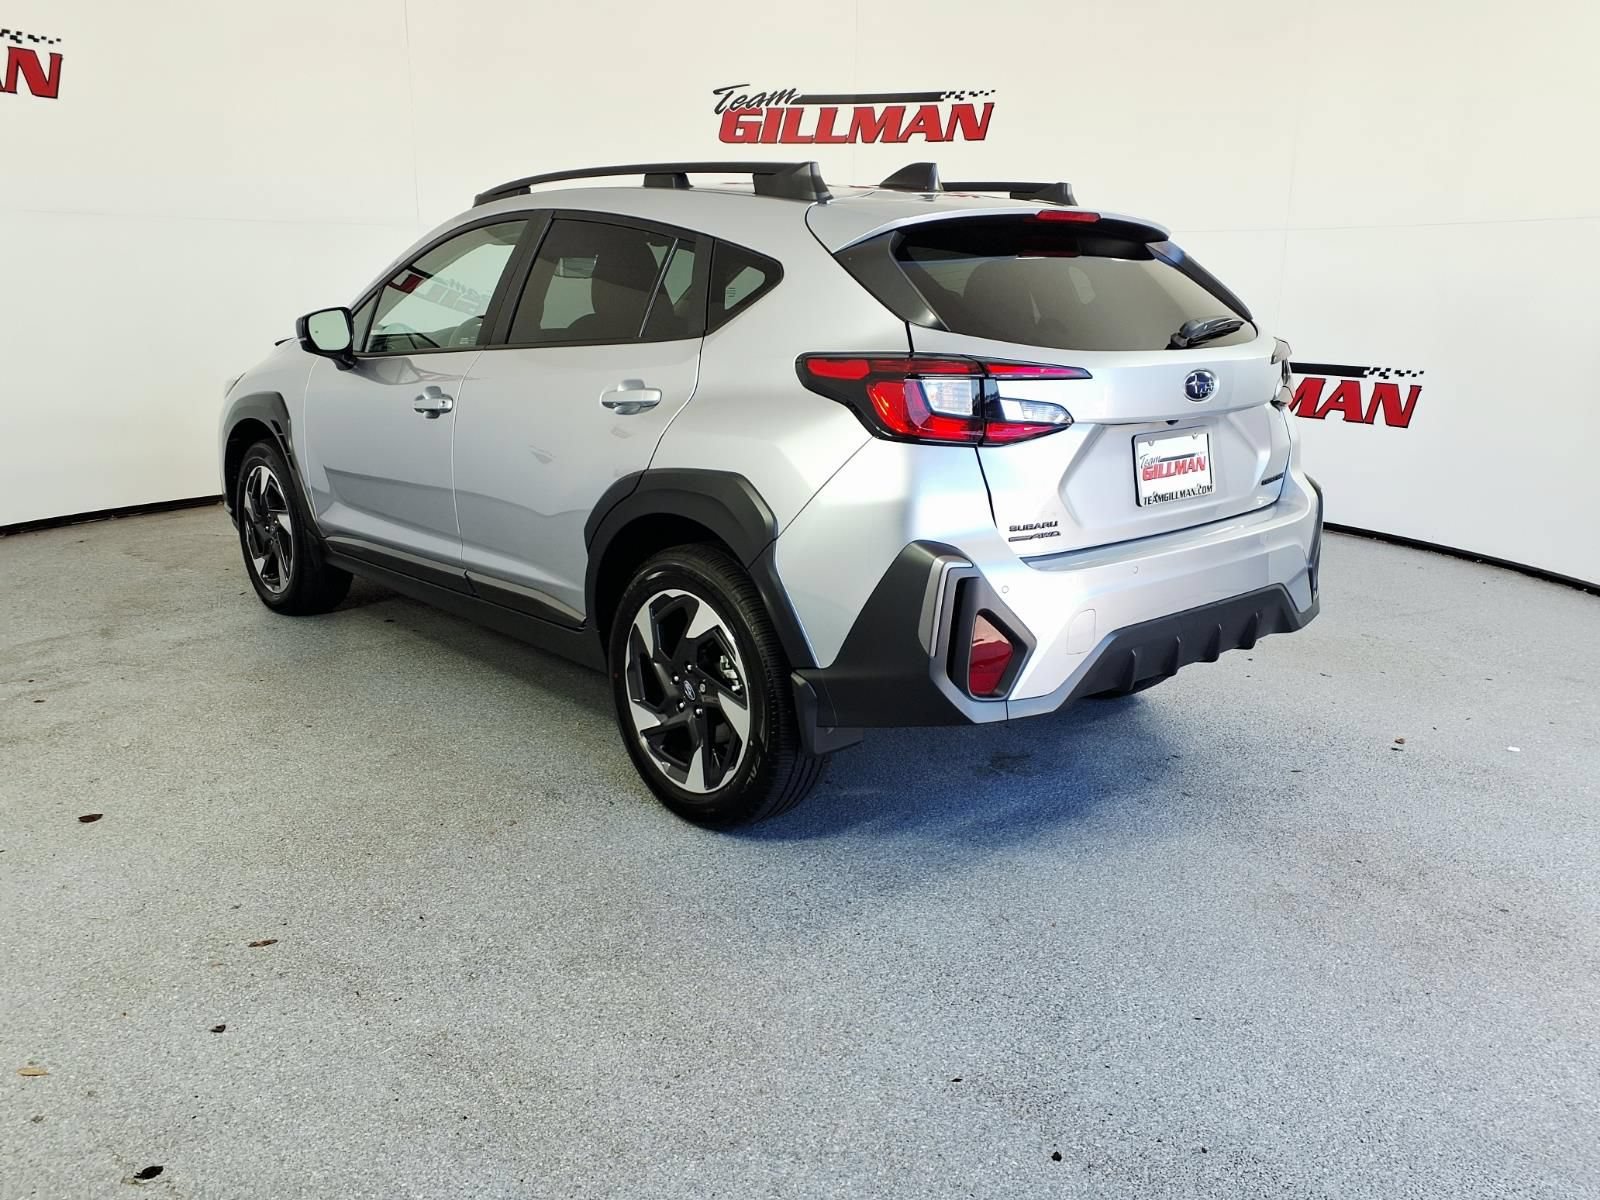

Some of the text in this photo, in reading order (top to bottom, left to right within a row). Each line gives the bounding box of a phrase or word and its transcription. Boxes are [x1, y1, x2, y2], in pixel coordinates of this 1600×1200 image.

[713, 84, 800, 115] Team
[719, 102, 995, 144] GILLMAN
[1142, 456, 1206, 481] GILLMAN
[1143, 485, 1213, 506] TEAMGILLMAN.COM
[1009, 520, 1058, 531] SUBARU
